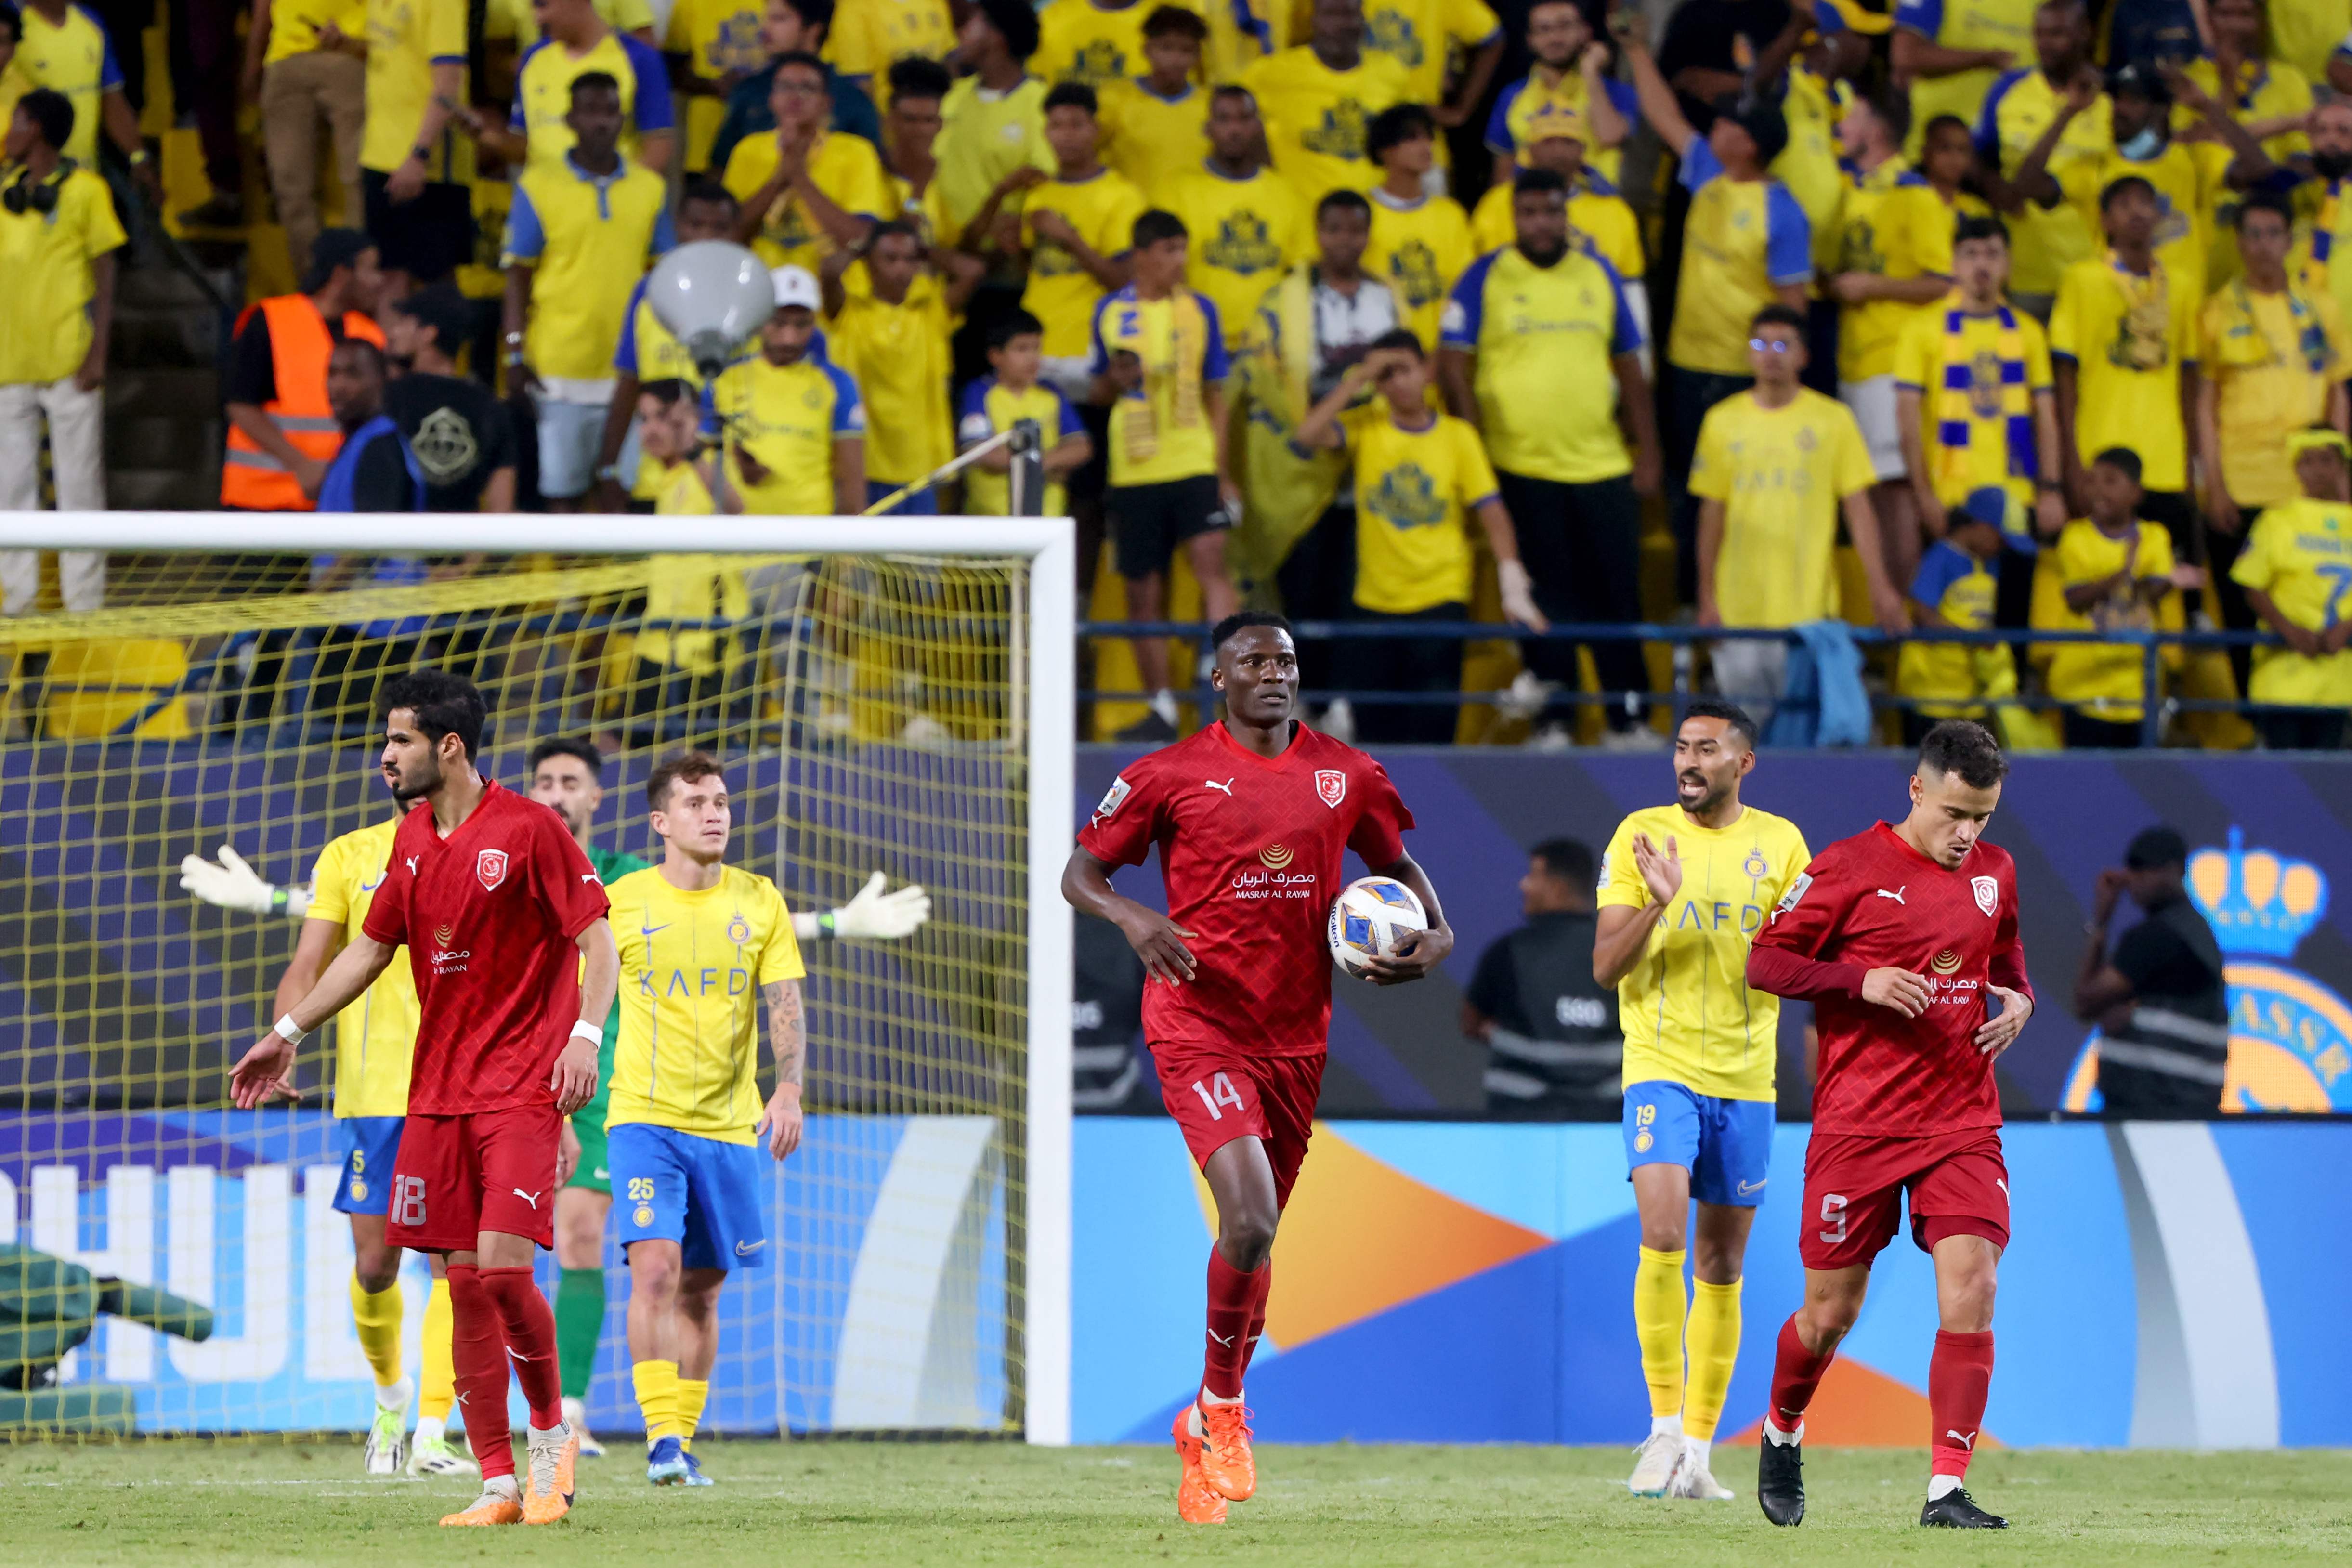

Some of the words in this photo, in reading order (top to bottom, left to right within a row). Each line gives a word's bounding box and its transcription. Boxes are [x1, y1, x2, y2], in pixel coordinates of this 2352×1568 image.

[1232, 871, 1269, 888] الريان
[1270, 871, 1316, 887] مصرف
[1236, 890, 1269, 899] MASRAF
[1271, 890, 1282, 898] AL
[1286, 889, 1310, 899] RAYAN
[1331, 906, 1339, 948] molten
[638, 967, 748, 997] KAFD
[1940, 978, 1978, 993] مصرف
[1940, 996, 1950, 1004] AL
[1192, 1071, 1245, 1121] 14
[1636, 1103, 1656, 1127] 19
[352, 1149, 365, 1174] 5
[390, 1174, 427, 1226] 18
[627, 1177, 655, 1200] 25
[1819, 1193, 1848, 1243] 9
